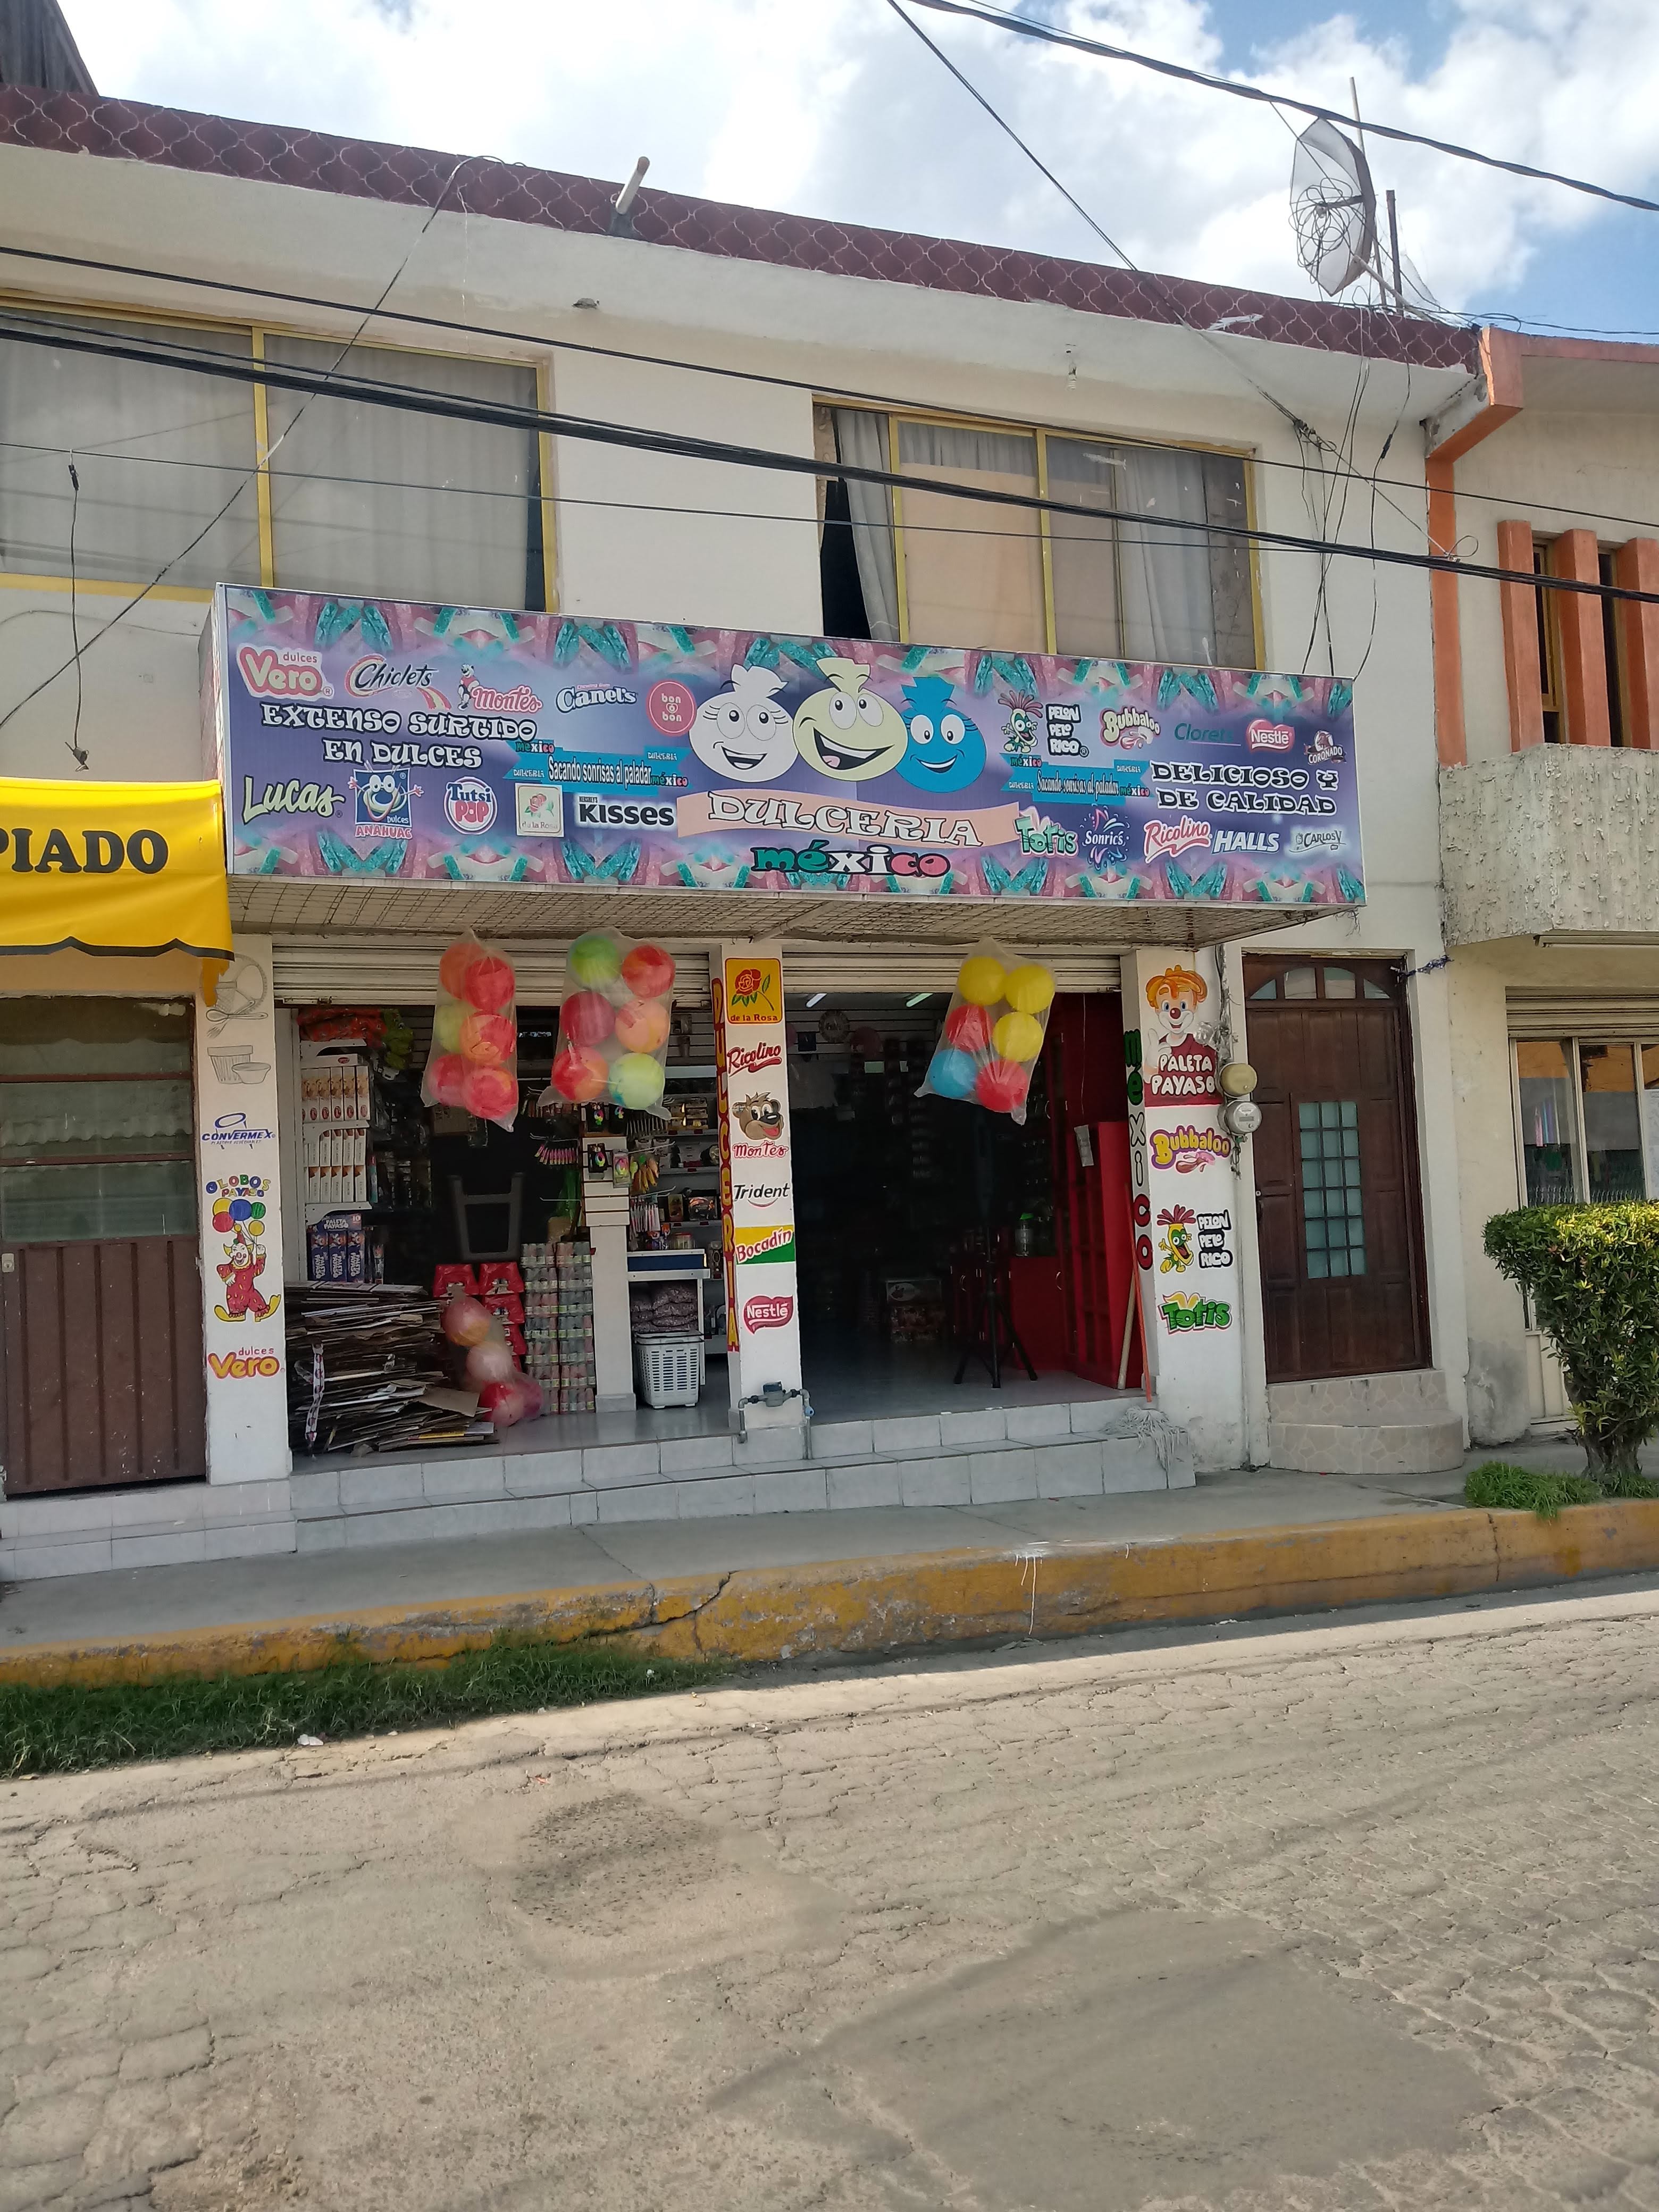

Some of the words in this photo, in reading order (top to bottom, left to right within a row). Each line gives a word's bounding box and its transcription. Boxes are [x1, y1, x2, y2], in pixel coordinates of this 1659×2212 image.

[282, 651, 317, 664] dulces
[241, 648, 320, 694] Vero
[355, 661, 439, 691] Chiclets
[556, 686, 637, 713] Canel's
[661, 692, 681, 703] bon
[261, 703, 401, 734] EXTENSO
[408, 711, 537, 741] SURTIDO
[661, 711, 682, 722] bon
[1048, 706, 1080, 721] PELON
[1049, 723, 1072, 737] PELO
[1102, 708, 1160, 743] Bubbaloo
[323, 739, 364, 764] EN
[371, 741, 483, 768] DULCES
[1049, 738, 1080, 754] RICO
[1308, 746, 1343, 765] CORONADO
[1011, 754, 1042, 767] méxico
[548, 755, 581, 782] Sacando
[582, 759, 614, 784] sonrisas
[616, 759, 623, 784] al
[624, 760, 652, 791] paladar
[652, 772, 689, 787] méxico
[1150, 761, 1309, 789] DELICIOSO
[1317, 770, 1338, 790] Y
[447, 783, 491, 802] Tutsi
[1037, 769, 1062, 793] Sacando
[1088, 773, 1094, 794] al
[1095, 774, 1119, 801] paladar
[1120, 784, 1150, 797] méxico
[242, 775, 345, 825] Lucas
[1156, 788, 1199, 809] DE
[1206, 791, 1336, 816] CALIDAD
[388, 815, 409, 824] Dulces
[455, 802, 490, 823] POP
[708, 791, 983, 847] DULCERIA
[355, 824, 413, 840] ANAHUAC
[1145, 817, 1210, 851] Ricolino
[1212, 830, 1280, 853] HALLS
[0, 827, 169, 875] IADO
[751, 840, 951, 878] méxico
[727, 1042, 782, 1073] Ricolino
[1159, 1054, 1213, 1073] PALETA
[1150, 1074, 1216, 1095] PAYASO
[202, 1129, 274, 1141] CONVERMEX
[733, 1141, 790, 1159] Montes
[1124, 1028, 1153, 1270] méxico
[1152, 1126, 1231, 1166] Bubbaloo
[711, 977, 740, 1353] DULCERIA
[221, 1187, 265, 1197] PAYASO
[733, 1183, 791, 1201] Trident
[1197, 1211, 1229, 1230] PELON
[736, 1228, 793, 1263] Bocadín
[1199, 1234, 1224, 1248] PELO
[1200, 1252, 1230, 1267] RICO
[747, 1303, 789, 1319] Nestlé
[238, 1346, 274, 1355] dulces
[208, 1352, 280, 1379] Vero
